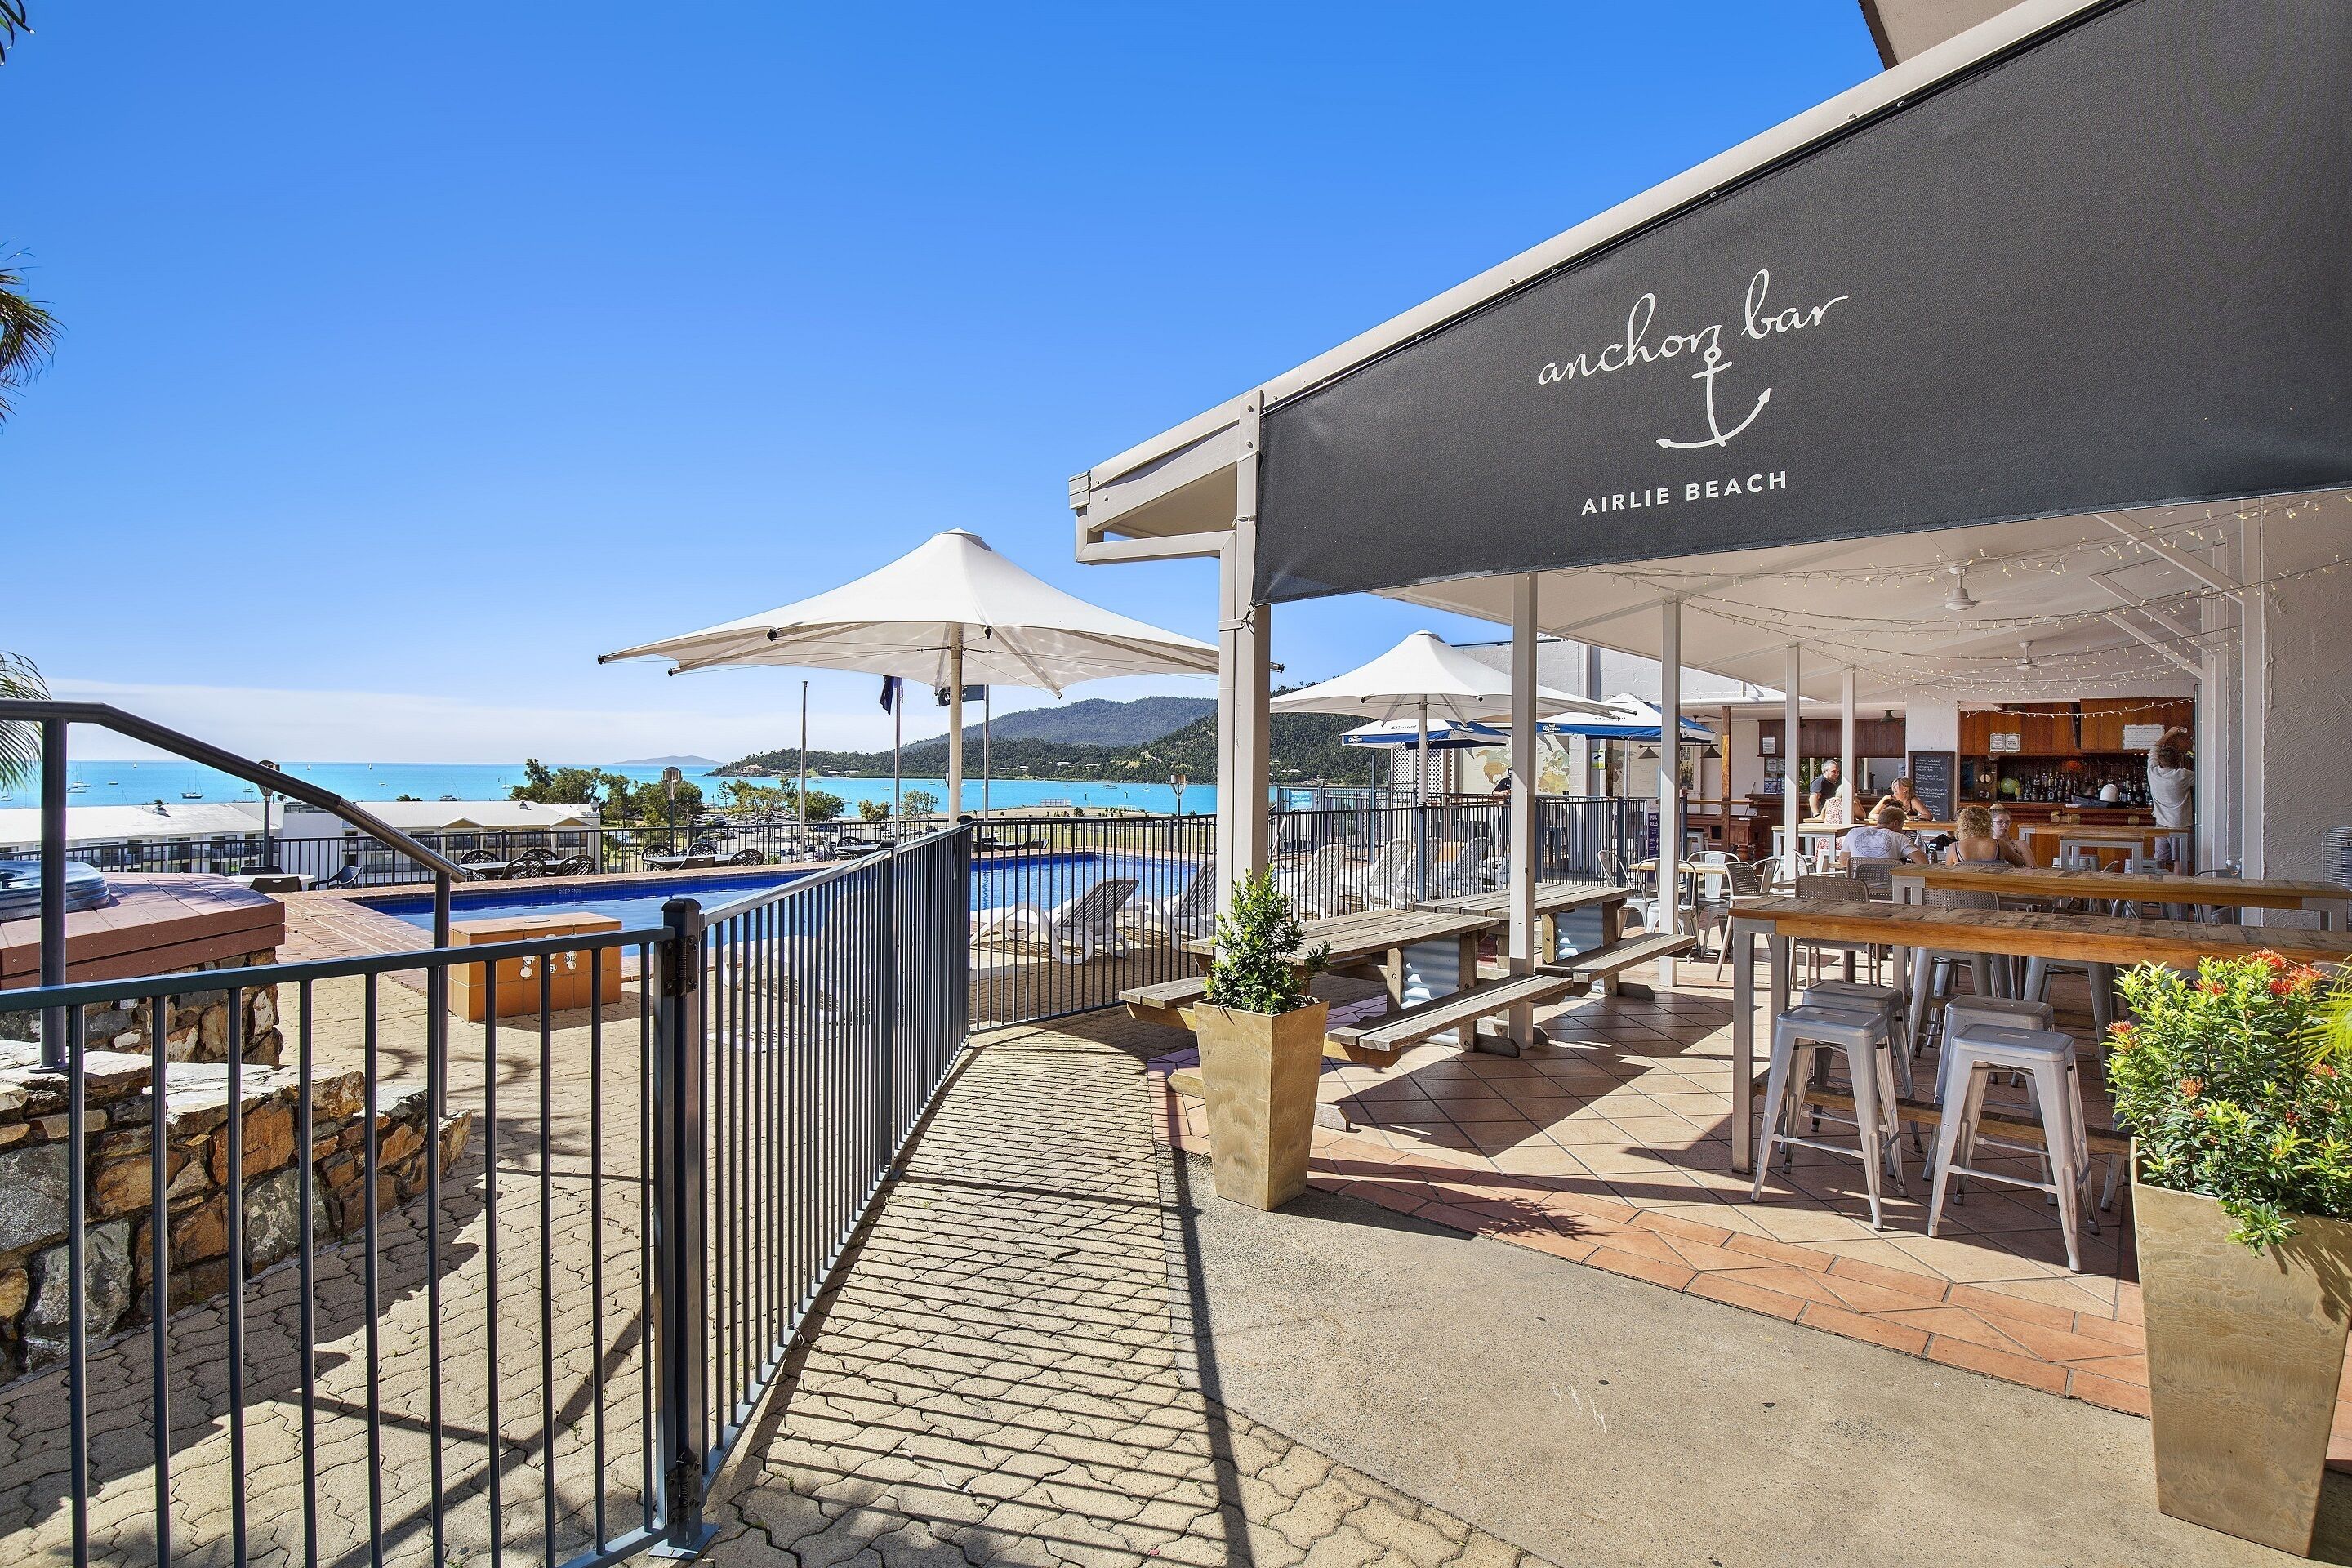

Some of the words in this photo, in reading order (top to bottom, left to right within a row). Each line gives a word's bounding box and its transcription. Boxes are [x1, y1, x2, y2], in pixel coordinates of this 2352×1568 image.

[1539, 292, 1722, 385] anchor
[1740, 269, 1849, 340] bar
[1581, 487, 1669, 514] AIRLIE
[1686, 470, 1787, 501] BEACH
